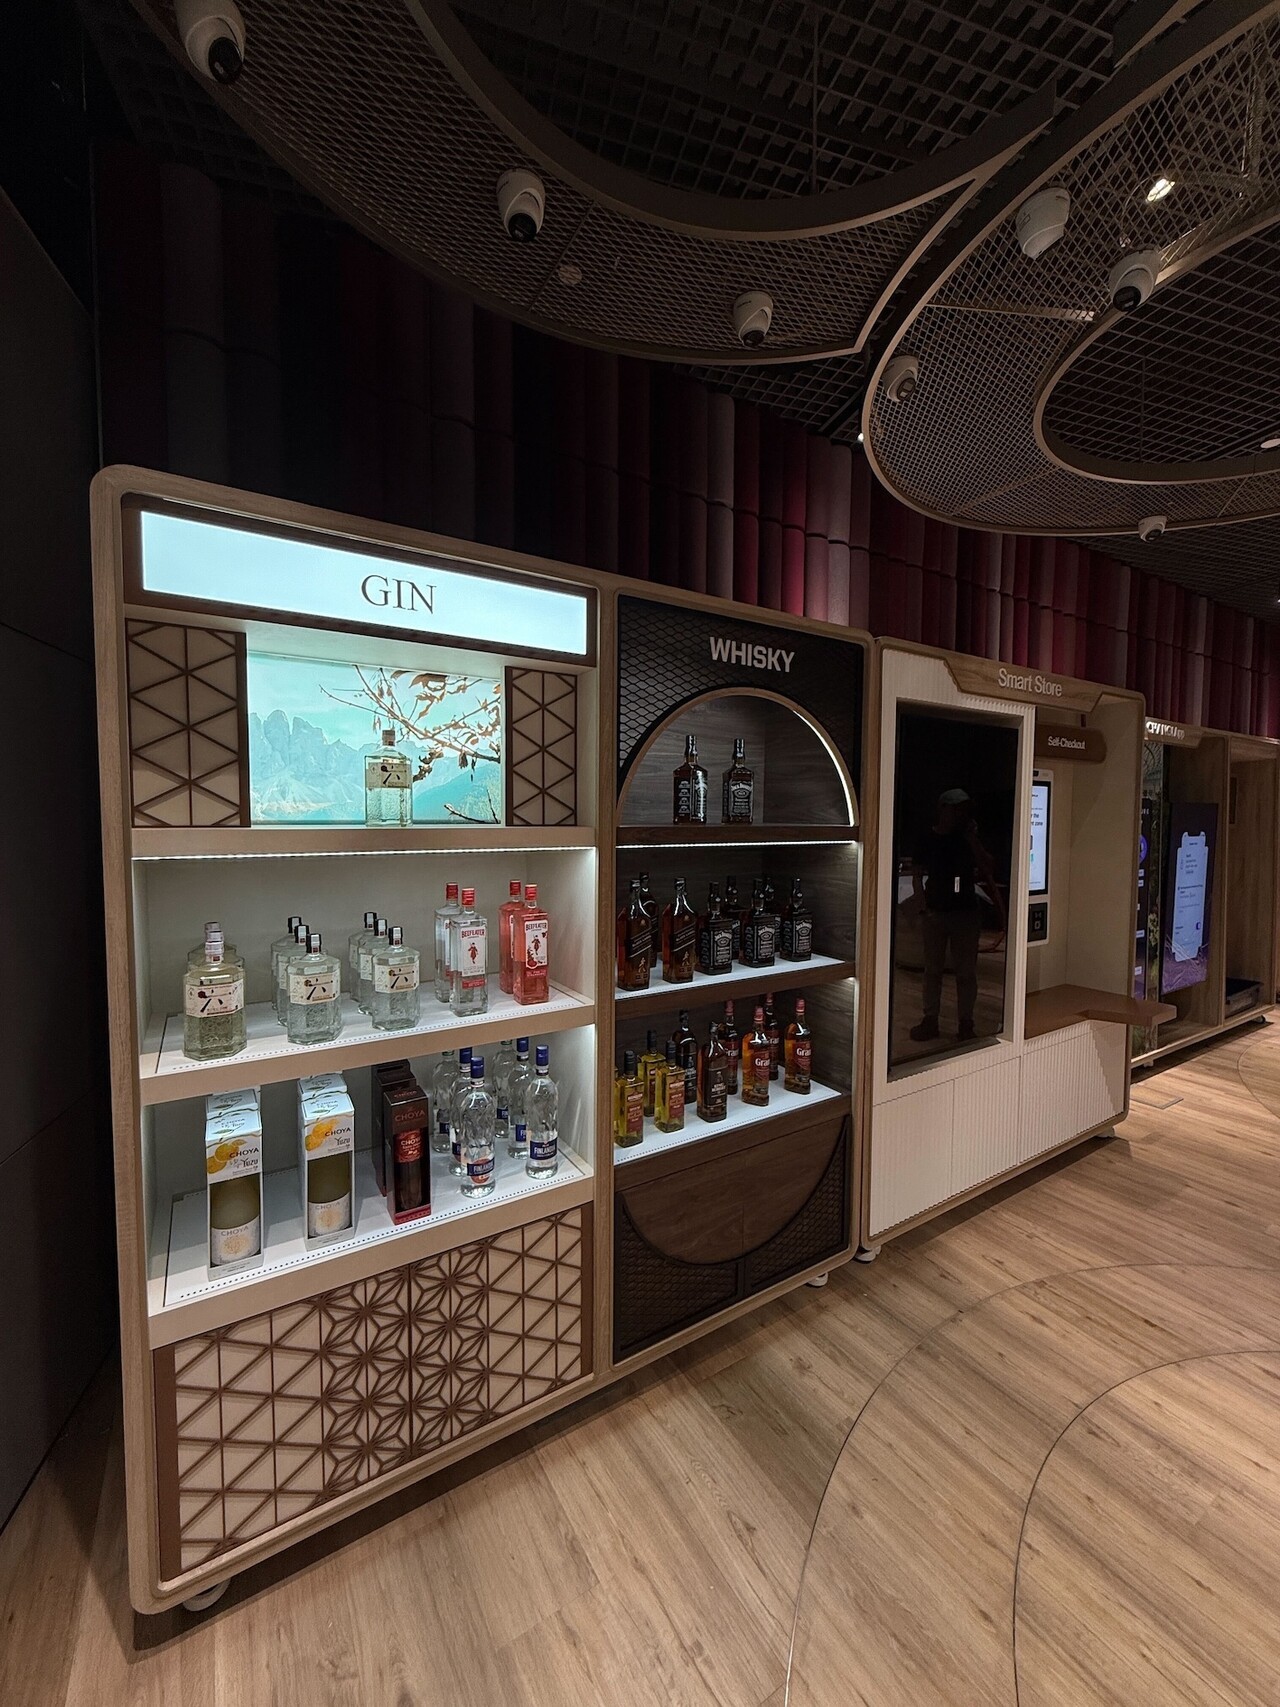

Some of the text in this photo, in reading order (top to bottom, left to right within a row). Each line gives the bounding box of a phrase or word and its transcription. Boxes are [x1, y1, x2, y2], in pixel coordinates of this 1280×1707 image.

[361, 574, 437, 614] GIN
[709, 636, 795, 673] WHISKY
[998, 668, 1062, 697] Smart Store
[1048, 736, 1086, 750] Self-Checkout
[461, 929, 485, 939] BEEFEATER
[394, 1110, 426, 1122] CHOYA
[324, 1127, 351, 1137] CHOYA
[401, 1137, 421, 1146] CHOY
[229, 1147, 259, 1158] CHOYA
[315, 1201, 340, 1210] CHOYA
[220, 1225, 249, 1237] CHOYA
